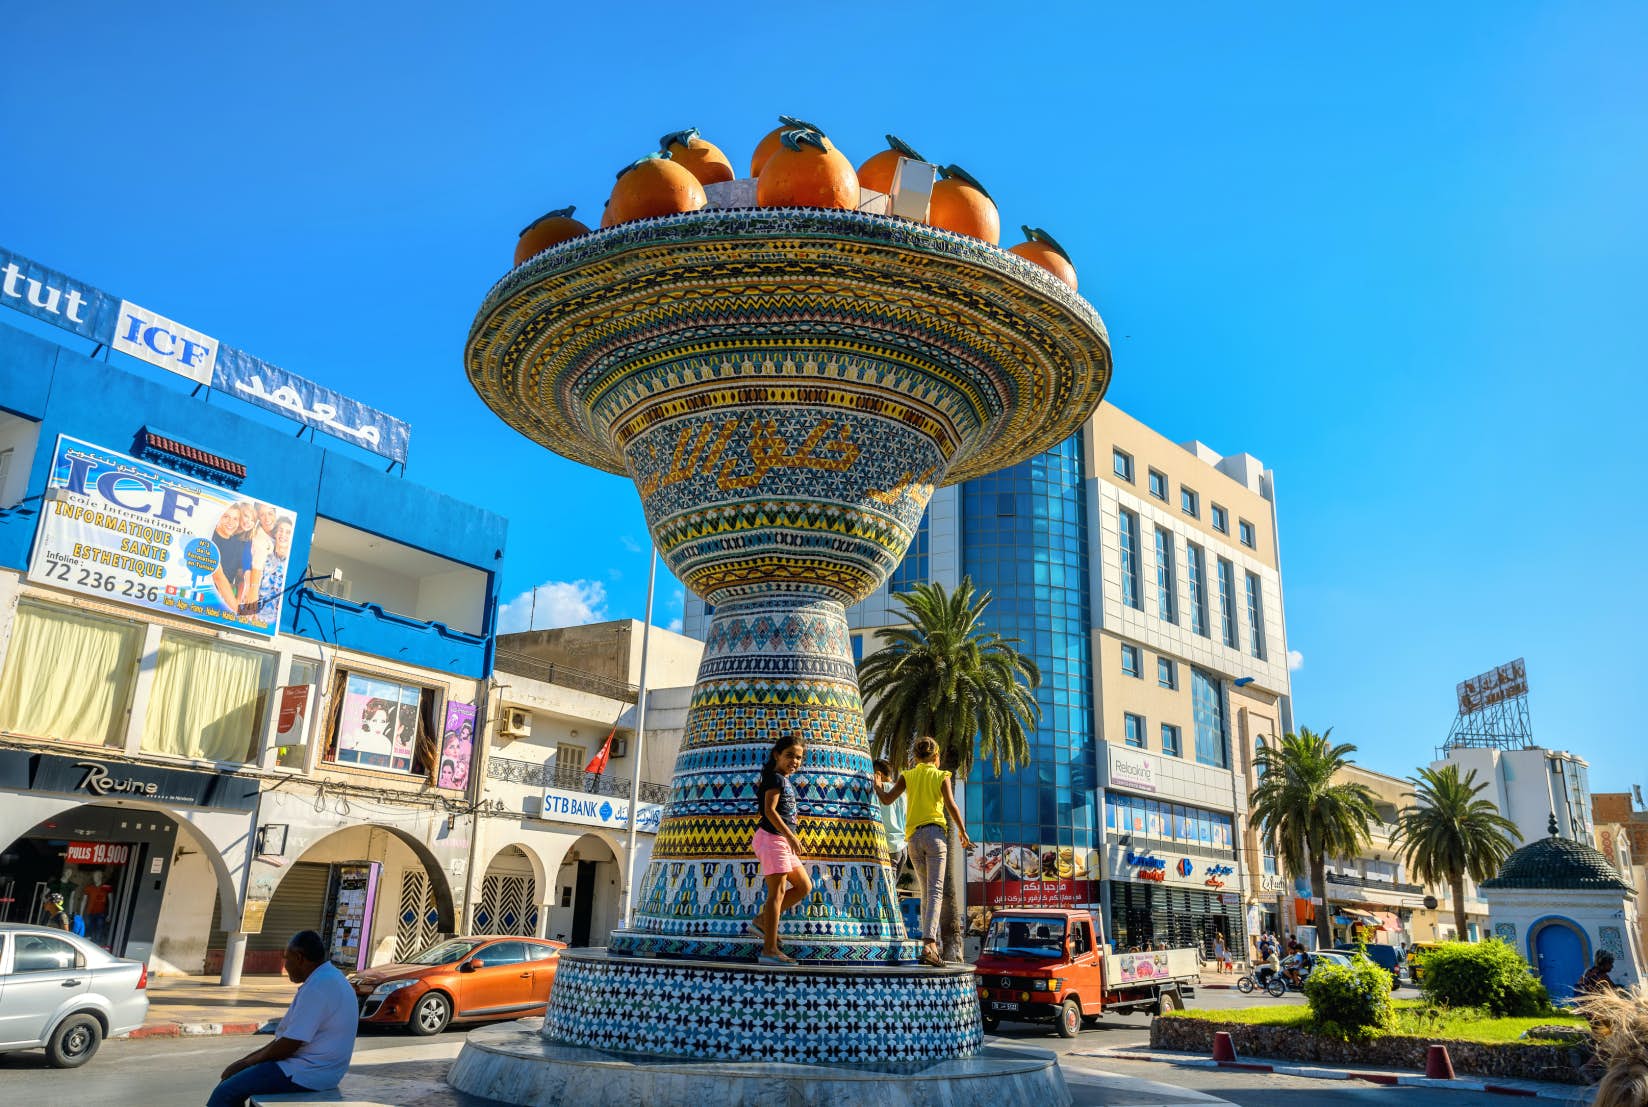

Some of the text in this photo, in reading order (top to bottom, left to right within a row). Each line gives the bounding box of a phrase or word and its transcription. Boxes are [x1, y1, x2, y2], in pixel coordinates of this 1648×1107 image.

[121, 313, 210, 368] ICF
[235, 375, 381, 448] معهد
[58, 454, 200, 525] ICF
[55, 500, 173, 546] INFORMATIQUE
[102, 502, 194, 536] Internationale
[46, 550, 79, 566] Infoline
[72, 543, 164, 580] ESTHETIQUE
[121, 537, 167, 562] SANTE
[44, 559, 159, 603] 72 236 236
[1115, 759, 1152, 780] Relooking
[544, 794, 598, 818] STB BANK
[67, 844, 129, 864] PULLS 19.900
